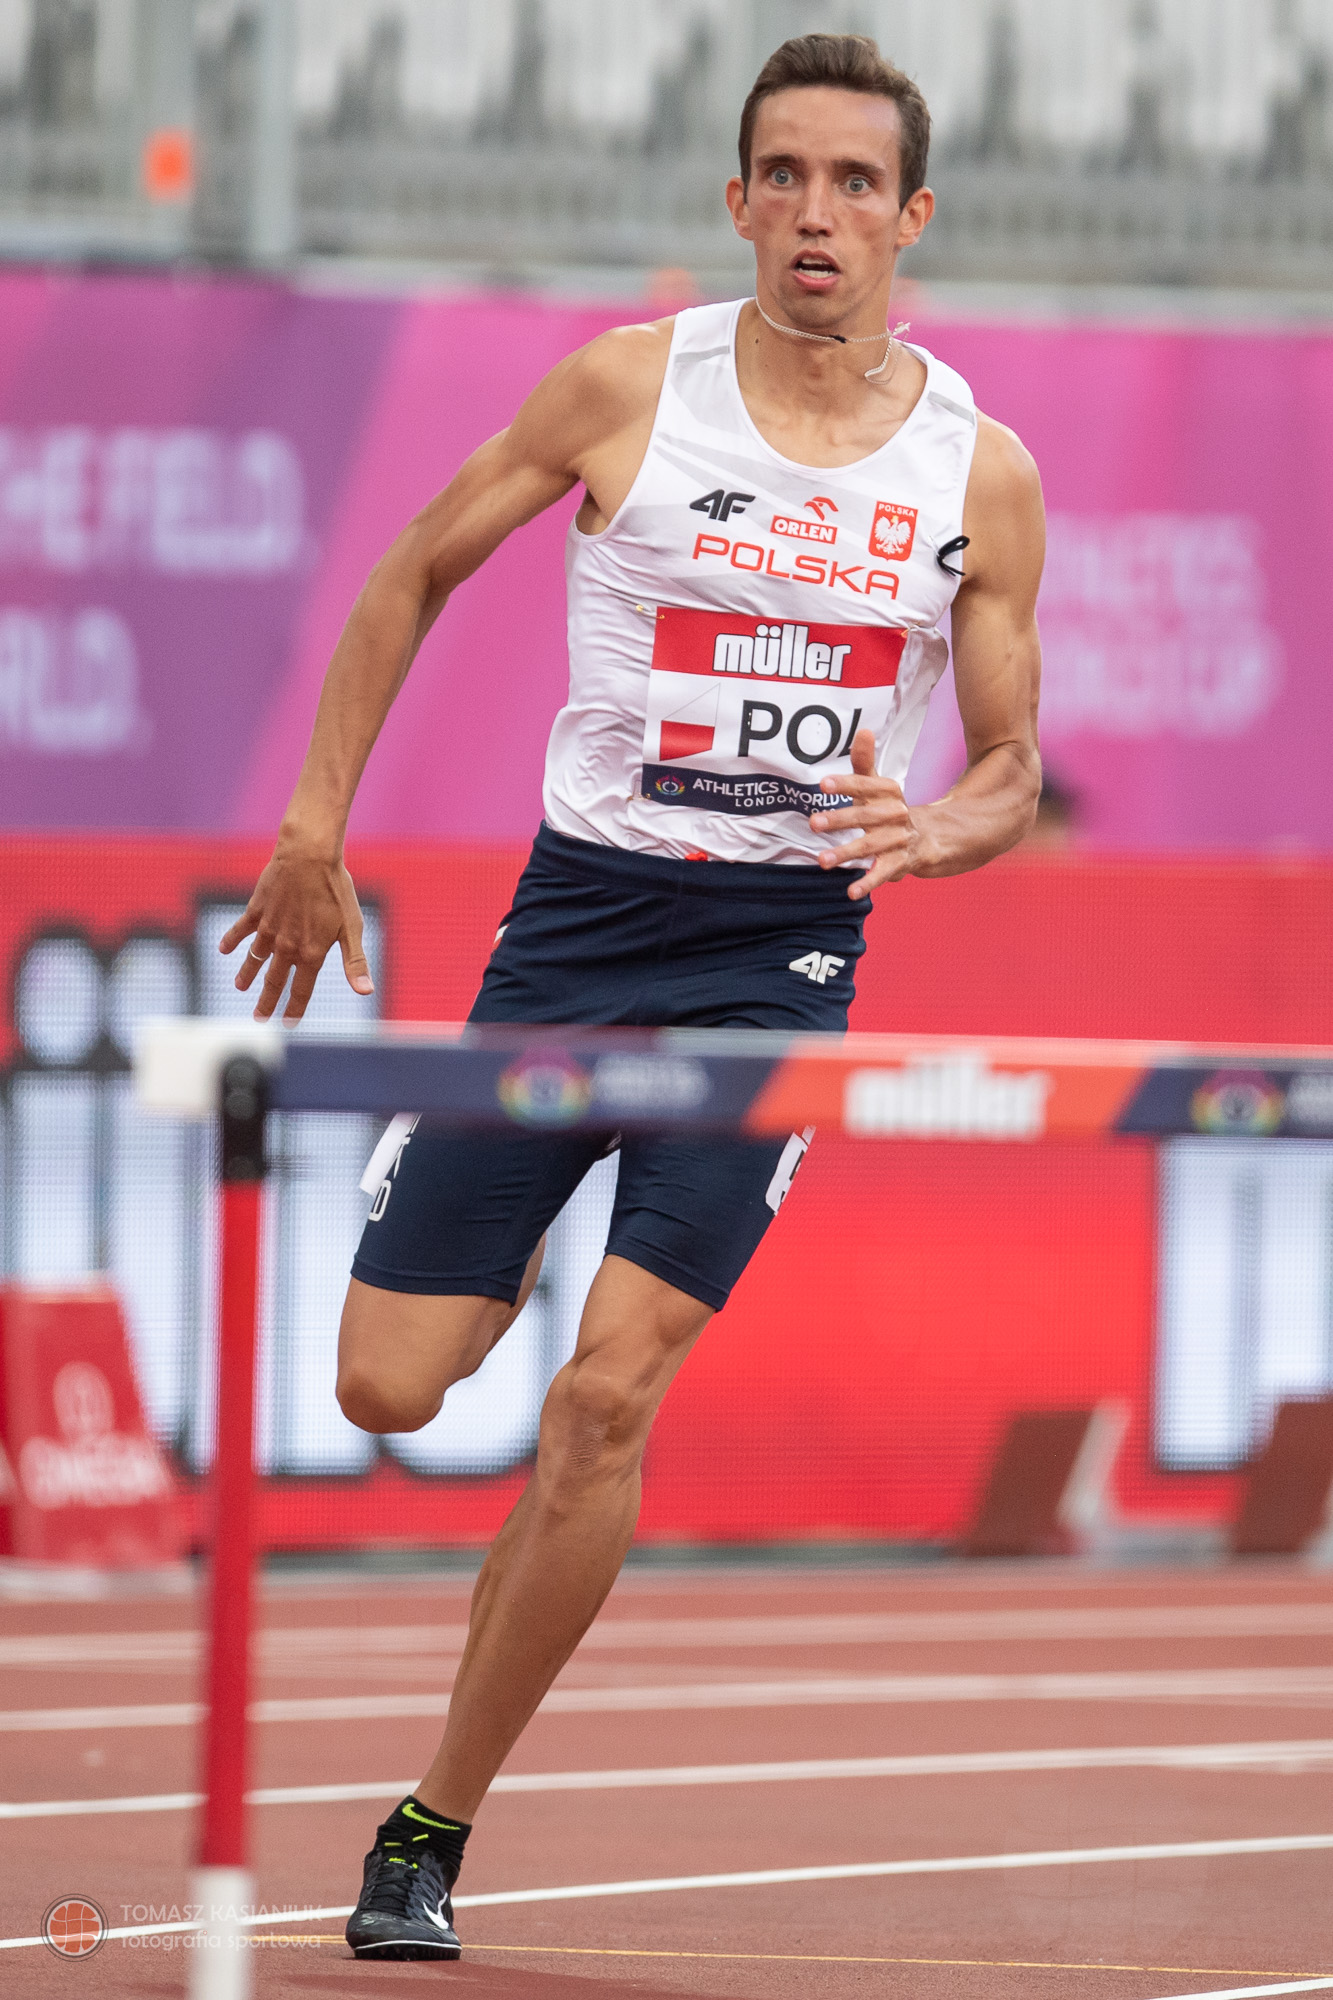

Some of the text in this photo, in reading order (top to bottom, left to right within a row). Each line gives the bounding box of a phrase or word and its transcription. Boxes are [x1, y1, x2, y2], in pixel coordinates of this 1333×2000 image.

[689, 489, 756, 522] 4F
[878, 503, 915, 518] POLSKA
[774, 518, 834, 542] ORLEN
[692, 532, 900, 600] POLSKA
[712, 623, 852, 682] müller
[692, 778, 780, 797] ATHLETICS
[784, 784, 840, 807] WORLD
[735, 794, 798, 807] LONDON
[789, 951, 846, 985] 4F
